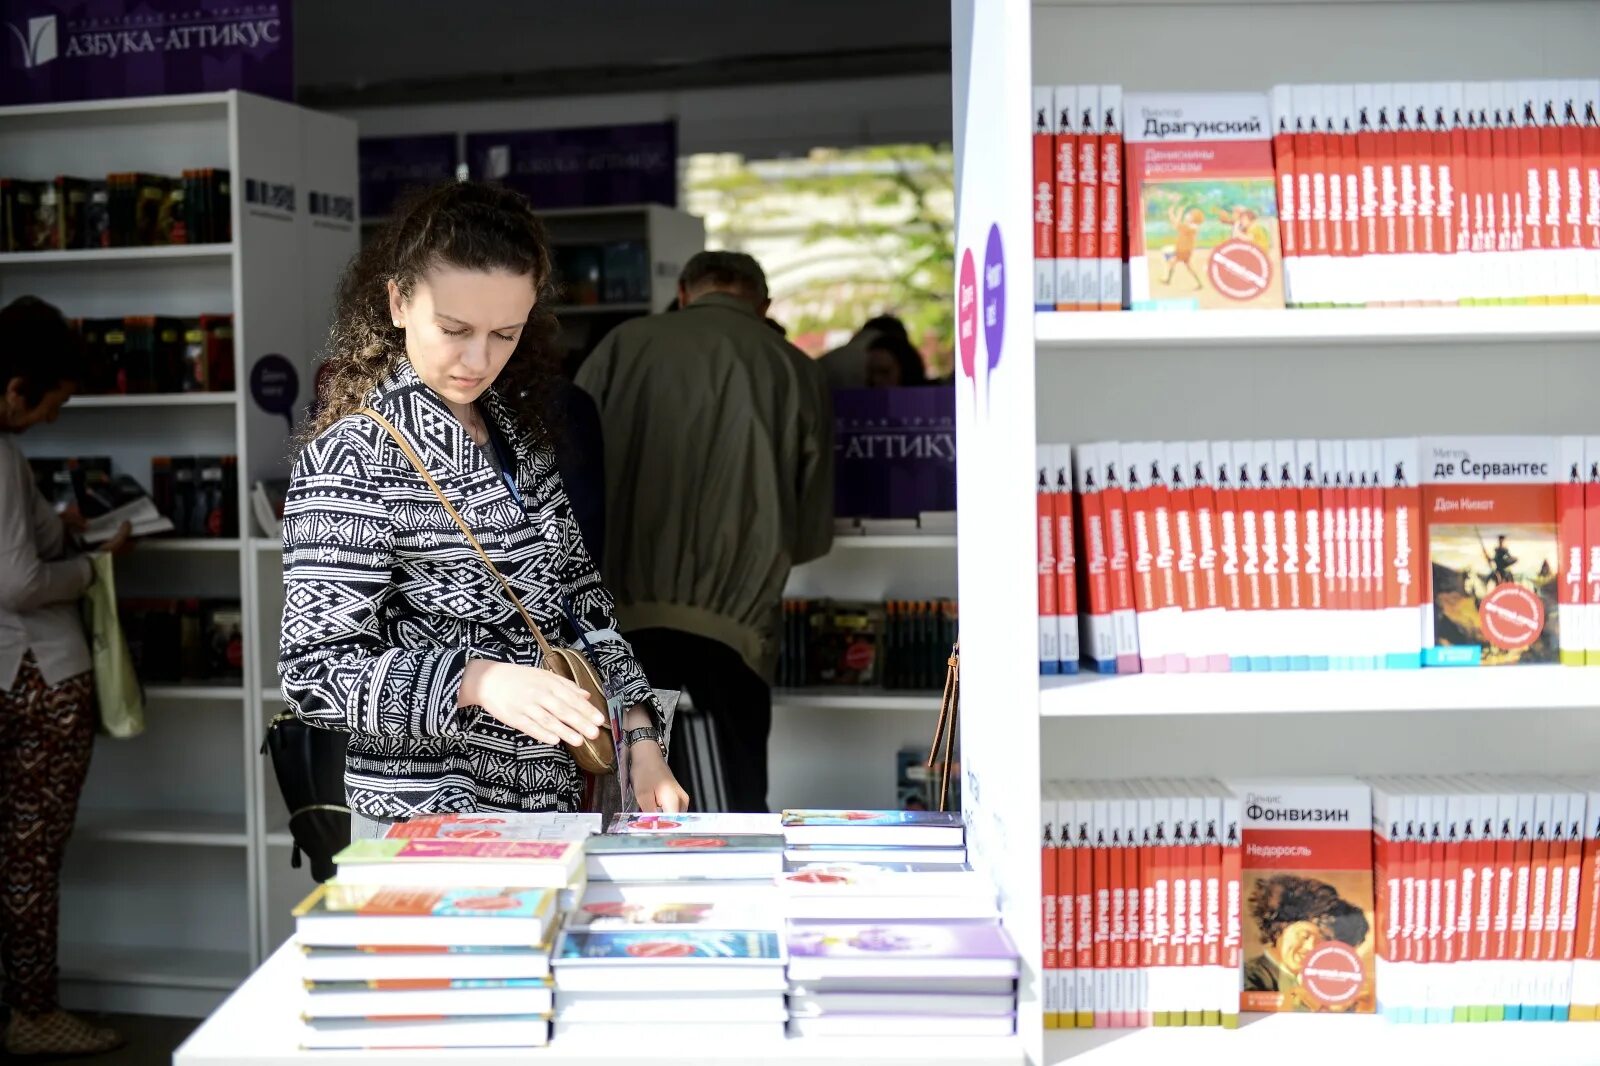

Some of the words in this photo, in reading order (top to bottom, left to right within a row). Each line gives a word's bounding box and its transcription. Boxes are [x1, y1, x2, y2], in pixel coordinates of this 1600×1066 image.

[64, 20, 280, 59] АЗБУКА-АТТИКУС
[1144, 116, 1260, 138] Драгунский
[1434, 462, 1454, 478] де
[1460, 459, 1548, 480] Сервантес
[1434, 498, 1459, 512] Дон
[1460, 498, 1494, 510] Кихот
[1247, 804, 1349, 822] Фонвизин
[1246, 844, 1312, 857] Недоросль
[1042, 895, 1056, 951] Толстой
[1058, 896, 1073, 951] Толстой
[1076, 895, 1091, 951] Толстой
[1095, 889, 1108, 942] Тютчев
[1110, 889, 1124, 941] Тютчев
[1124, 888, 1138, 941] Тютчев
[1140, 887, 1154, 940] Тютчев
